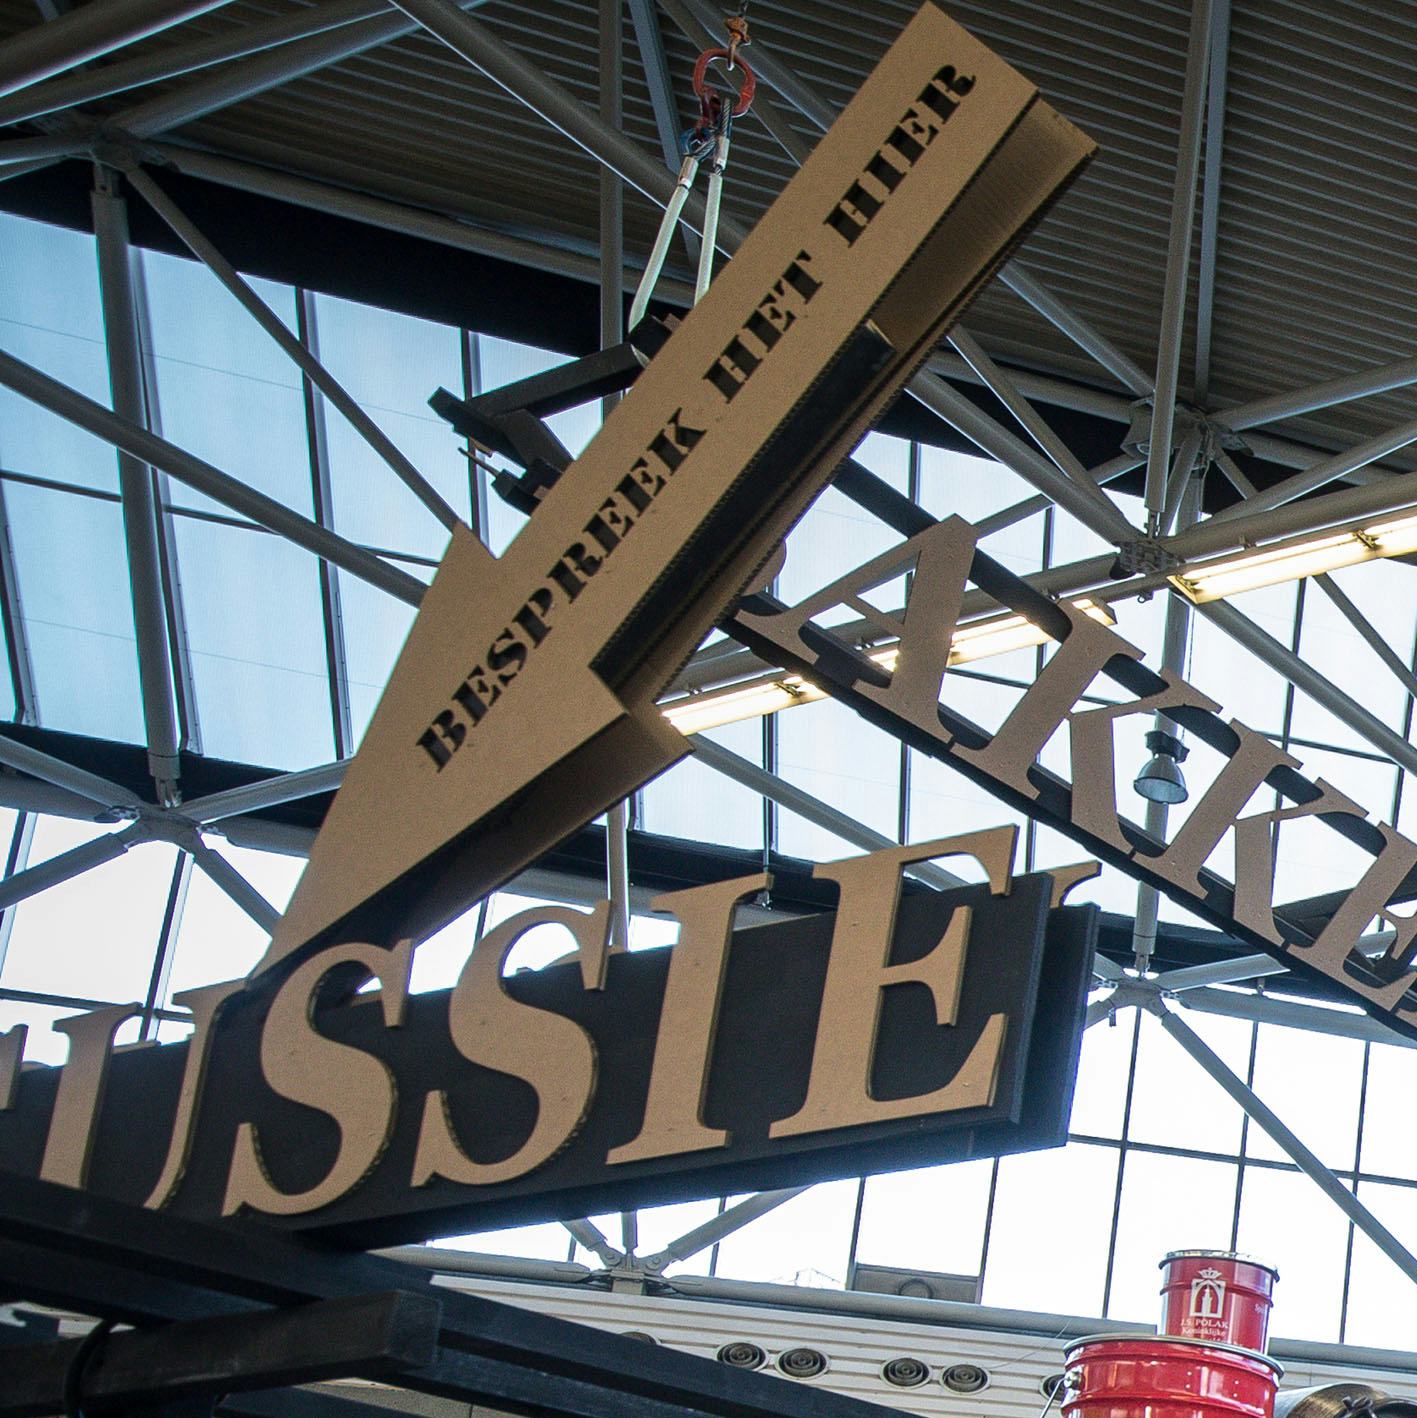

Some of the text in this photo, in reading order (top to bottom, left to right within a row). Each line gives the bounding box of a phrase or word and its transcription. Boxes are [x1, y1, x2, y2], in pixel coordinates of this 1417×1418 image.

[414, 61, 979, 775] BESPREEK HET HIER
[0, 824, 1020, 1216] USSIE
